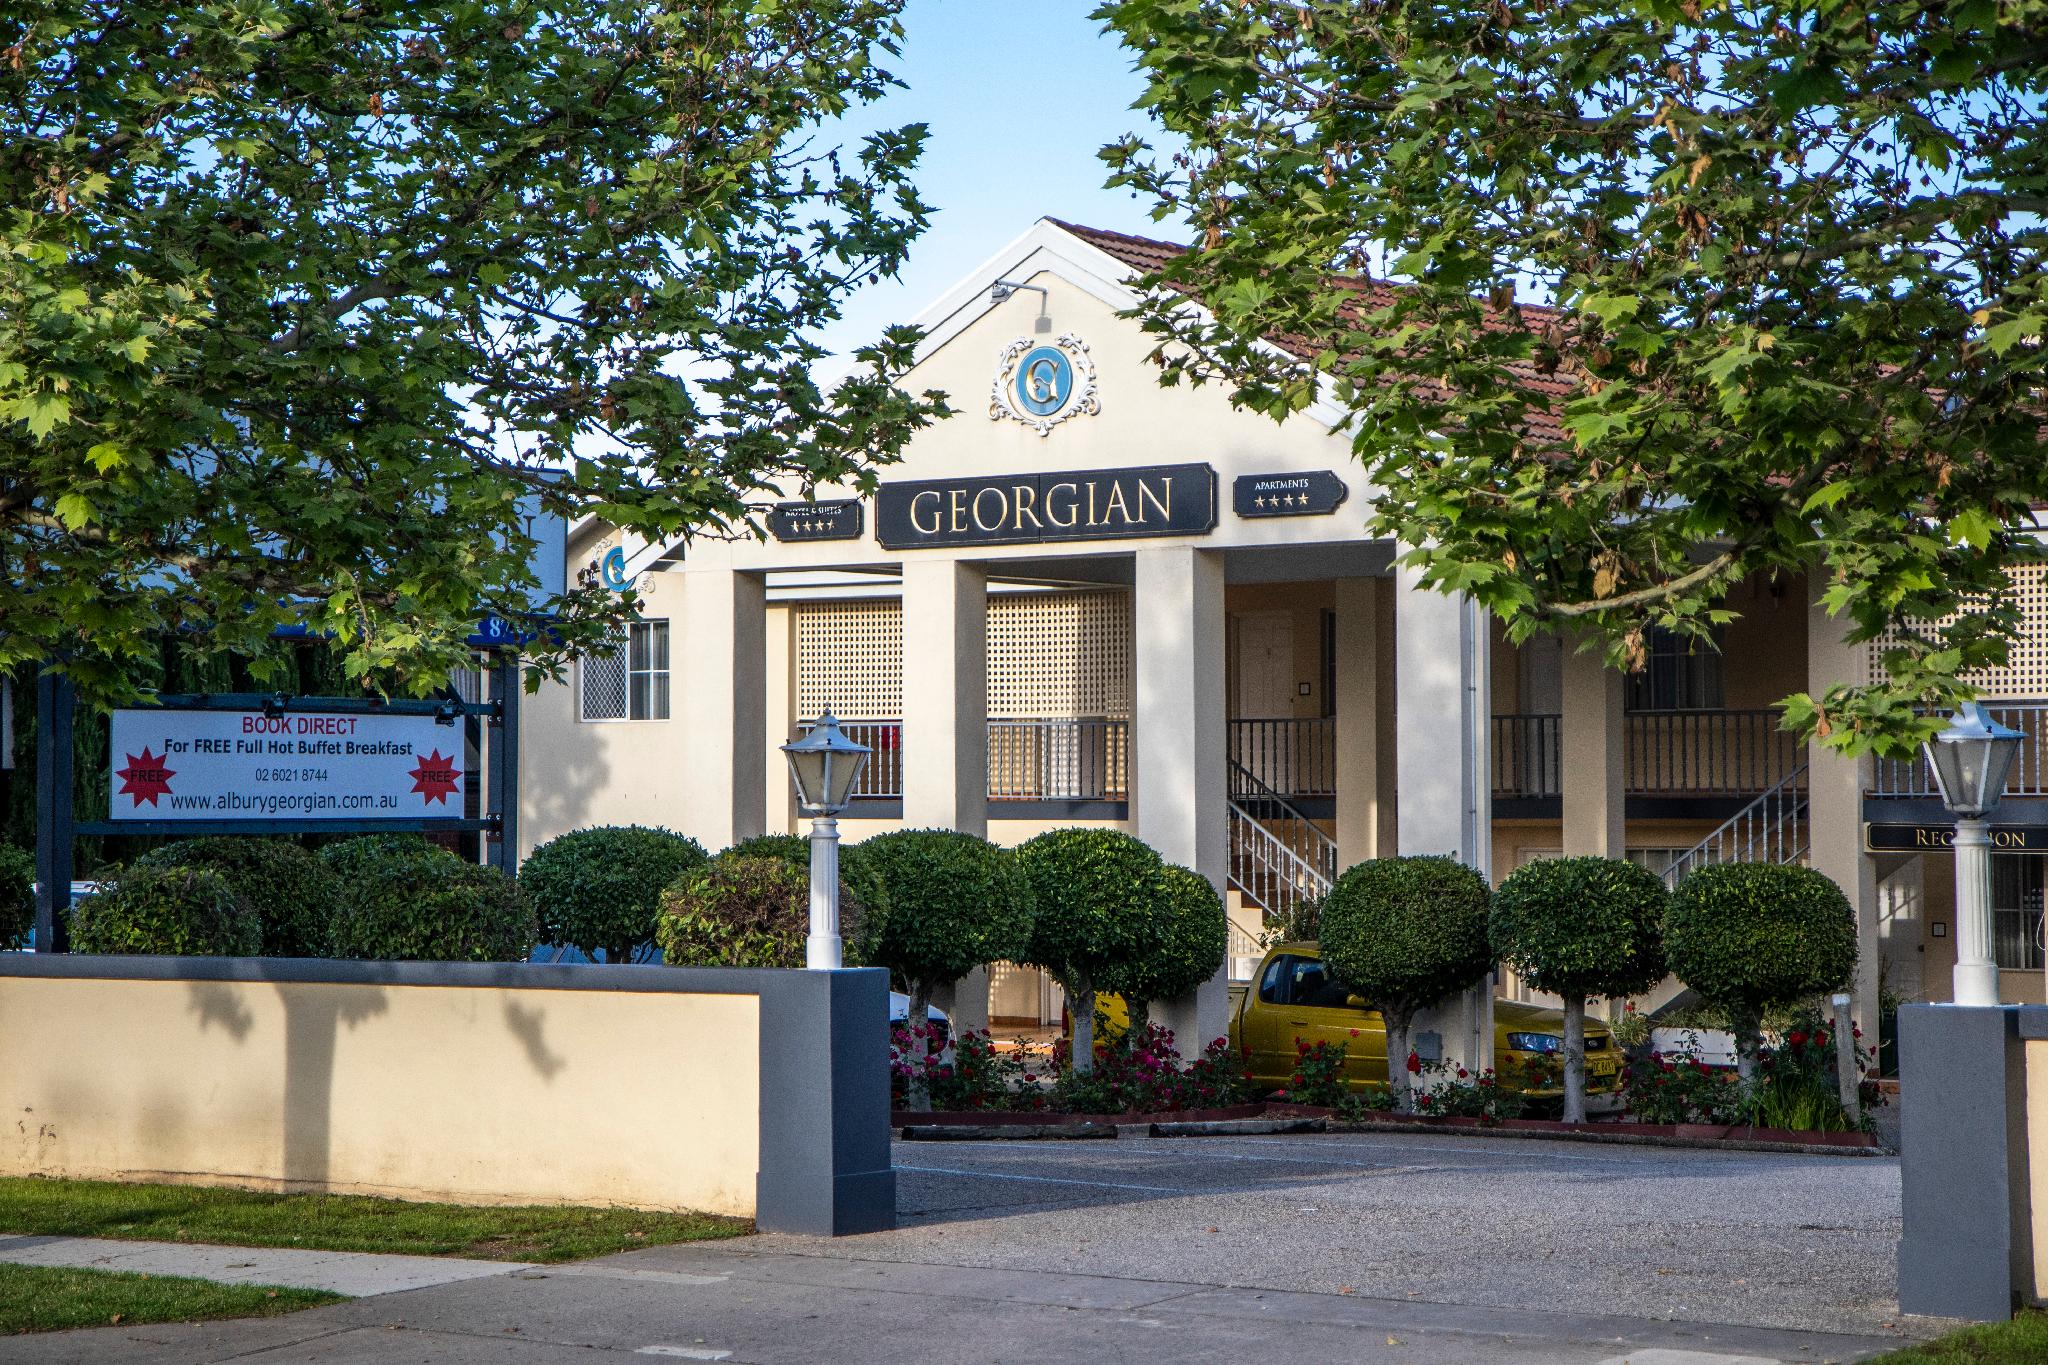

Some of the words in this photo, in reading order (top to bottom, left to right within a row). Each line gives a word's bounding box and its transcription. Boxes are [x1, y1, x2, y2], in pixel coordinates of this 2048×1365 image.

[1254, 479, 1309, 490] APARTMENTS
[910, 477, 1172, 535] GEORGIAN
[242, 716, 292, 733] BOOK
[298, 718, 357, 735] DIRECT
[165, 739, 189, 753] For
[194, 740, 231, 753] FREE
[236, 740, 262, 754] Full
[268, 741, 294, 754] Hot
[299, 741, 341, 755] Buffet
[346, 741, 412, 755] Breakfast
[130, 770, 164, 782] FREE
[255, 769, 269, 781] 02
[272, 769, 298, 782] 6021
[302, 769, 328, 781] 8744
[422, 771, 450, 782] FREE
[171, 791, 397, 813] www.alburygeorgian.com.au
